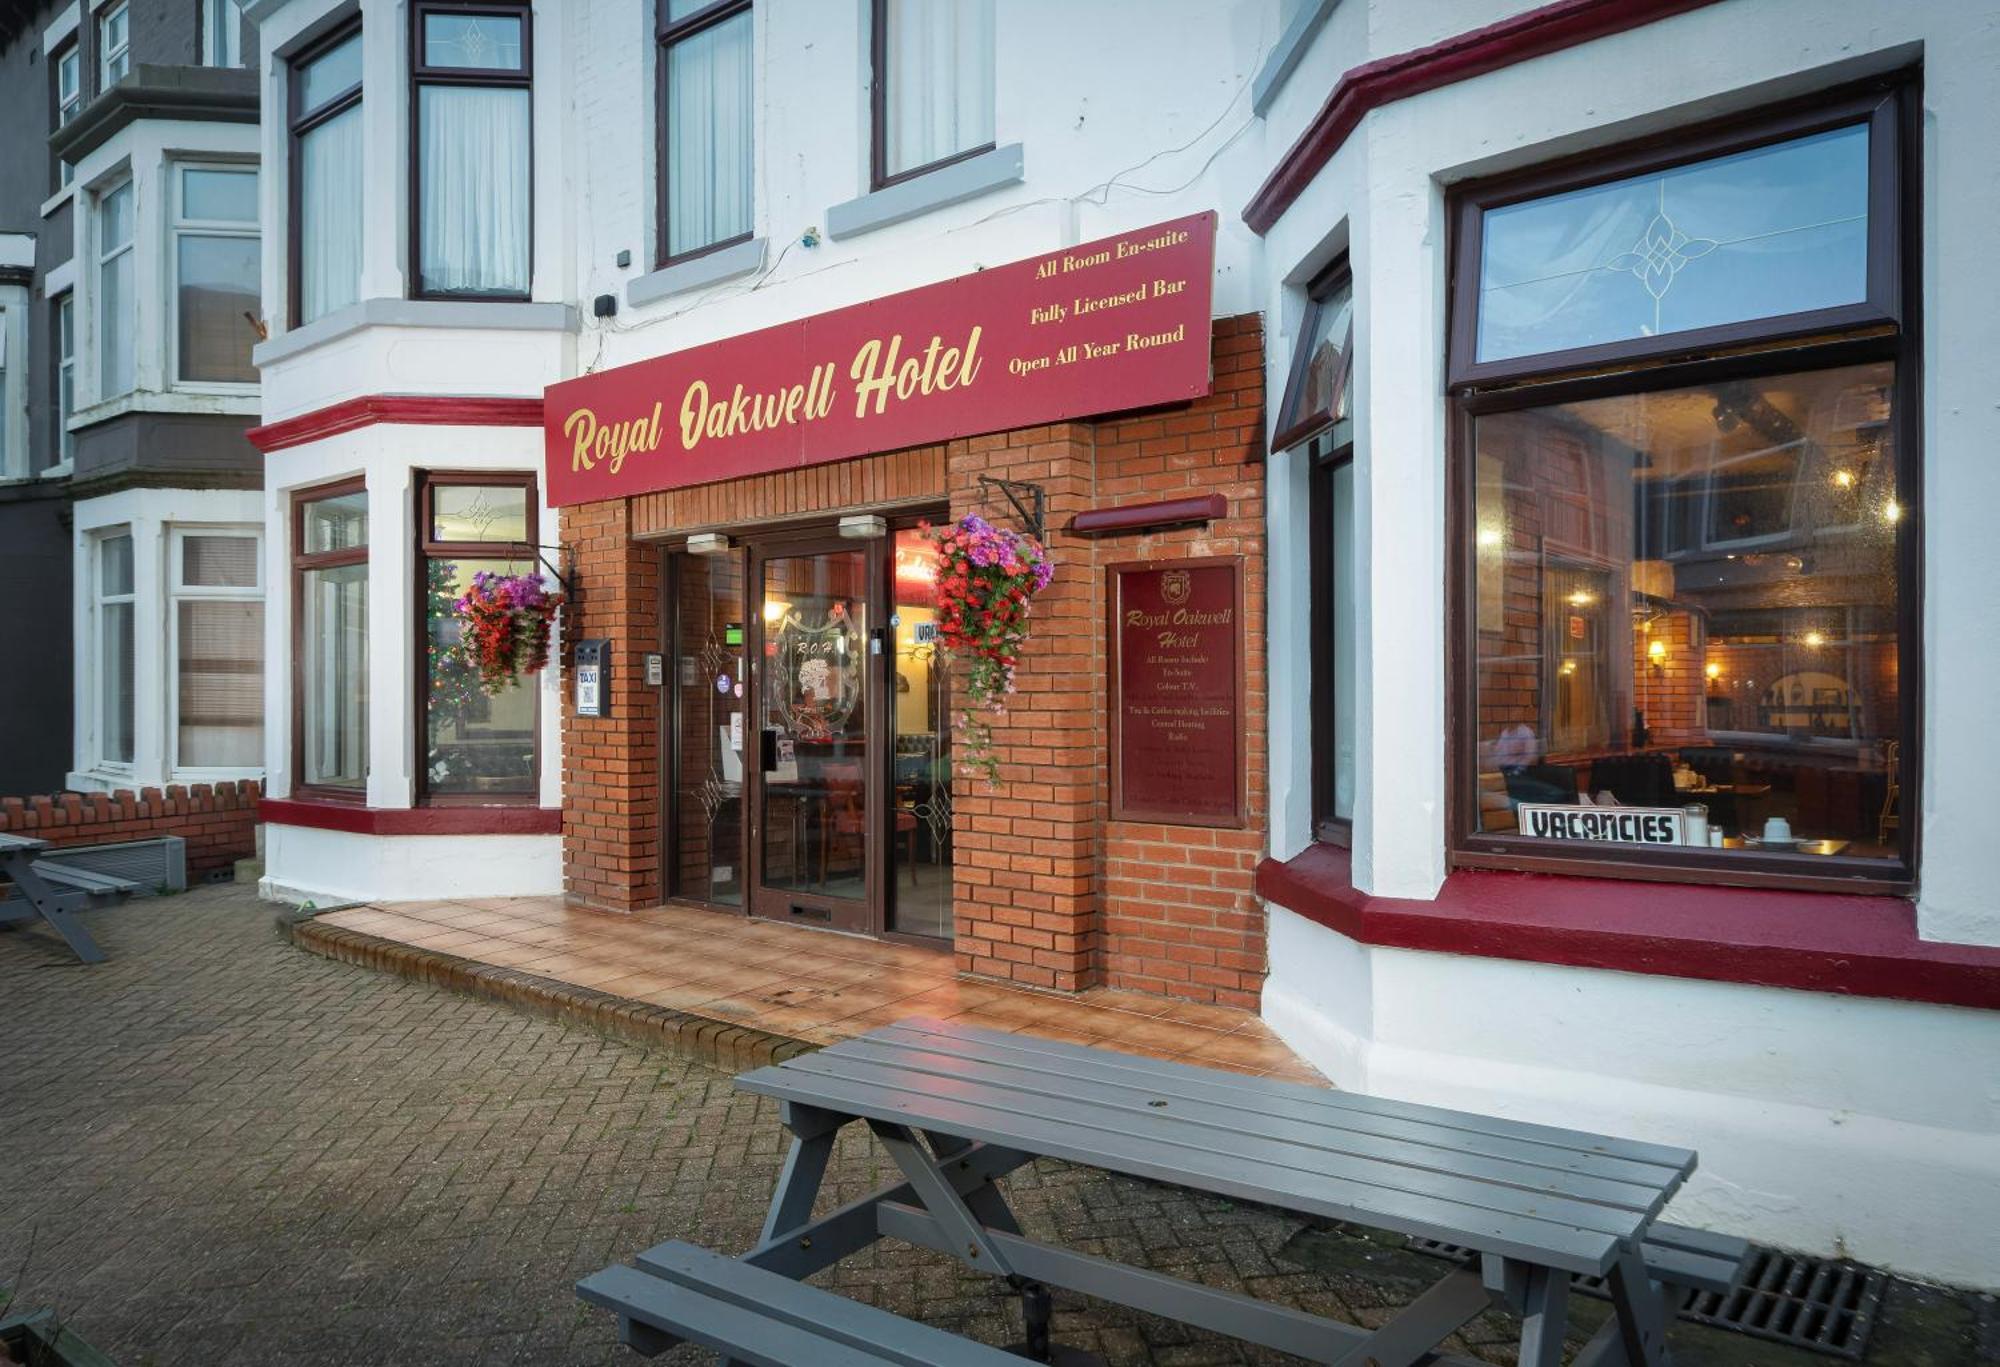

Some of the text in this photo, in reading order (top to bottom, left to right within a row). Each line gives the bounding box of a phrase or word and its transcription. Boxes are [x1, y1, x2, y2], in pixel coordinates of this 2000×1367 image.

[1035, 229, 1188, 280] All Room En-suite
[1030, 279, 1187, 324] Fully Licensed Bar
[1008, 324, 1185, 376] Open All Year Round
[564, 325, 983, 474] Royal Oakwell Hotel
[1127, 607, 1233, 630] Royal Oakwell
[1157, 631, 1199, 648] Hotel
[579, 671, 597, 684] TAXI
[1531, 811, 1674, 843] VACANCIES
